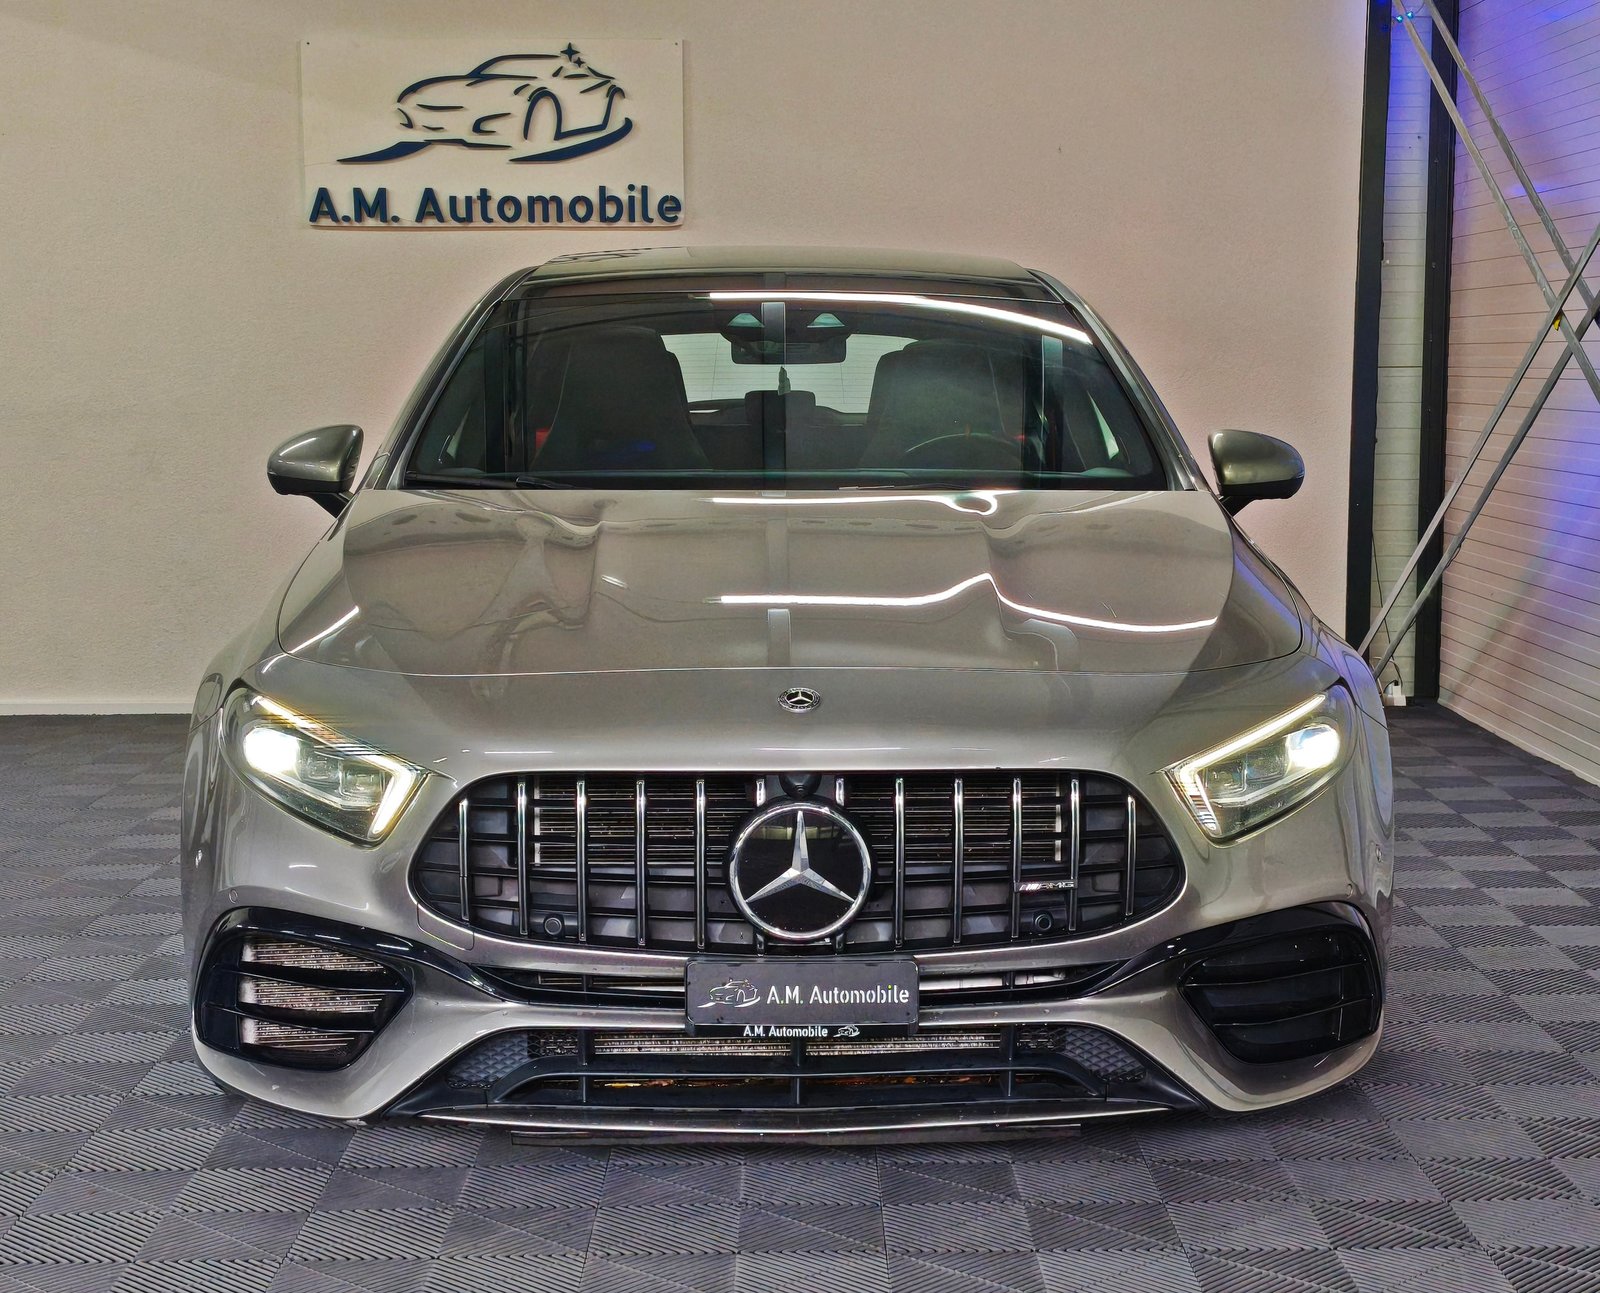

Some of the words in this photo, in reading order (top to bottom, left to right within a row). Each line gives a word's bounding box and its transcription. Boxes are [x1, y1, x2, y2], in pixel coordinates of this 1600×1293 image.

[309, 187, 400, 224] A.M.
[415, 183, 682, 224] Automobile
[766, 985, 804, 1005] A.M.
[809, 984, 910, 1005] Automobile
[743, 1024, 766, 1038] A.M.
[768, 1024, 829, 1038] Automobile
